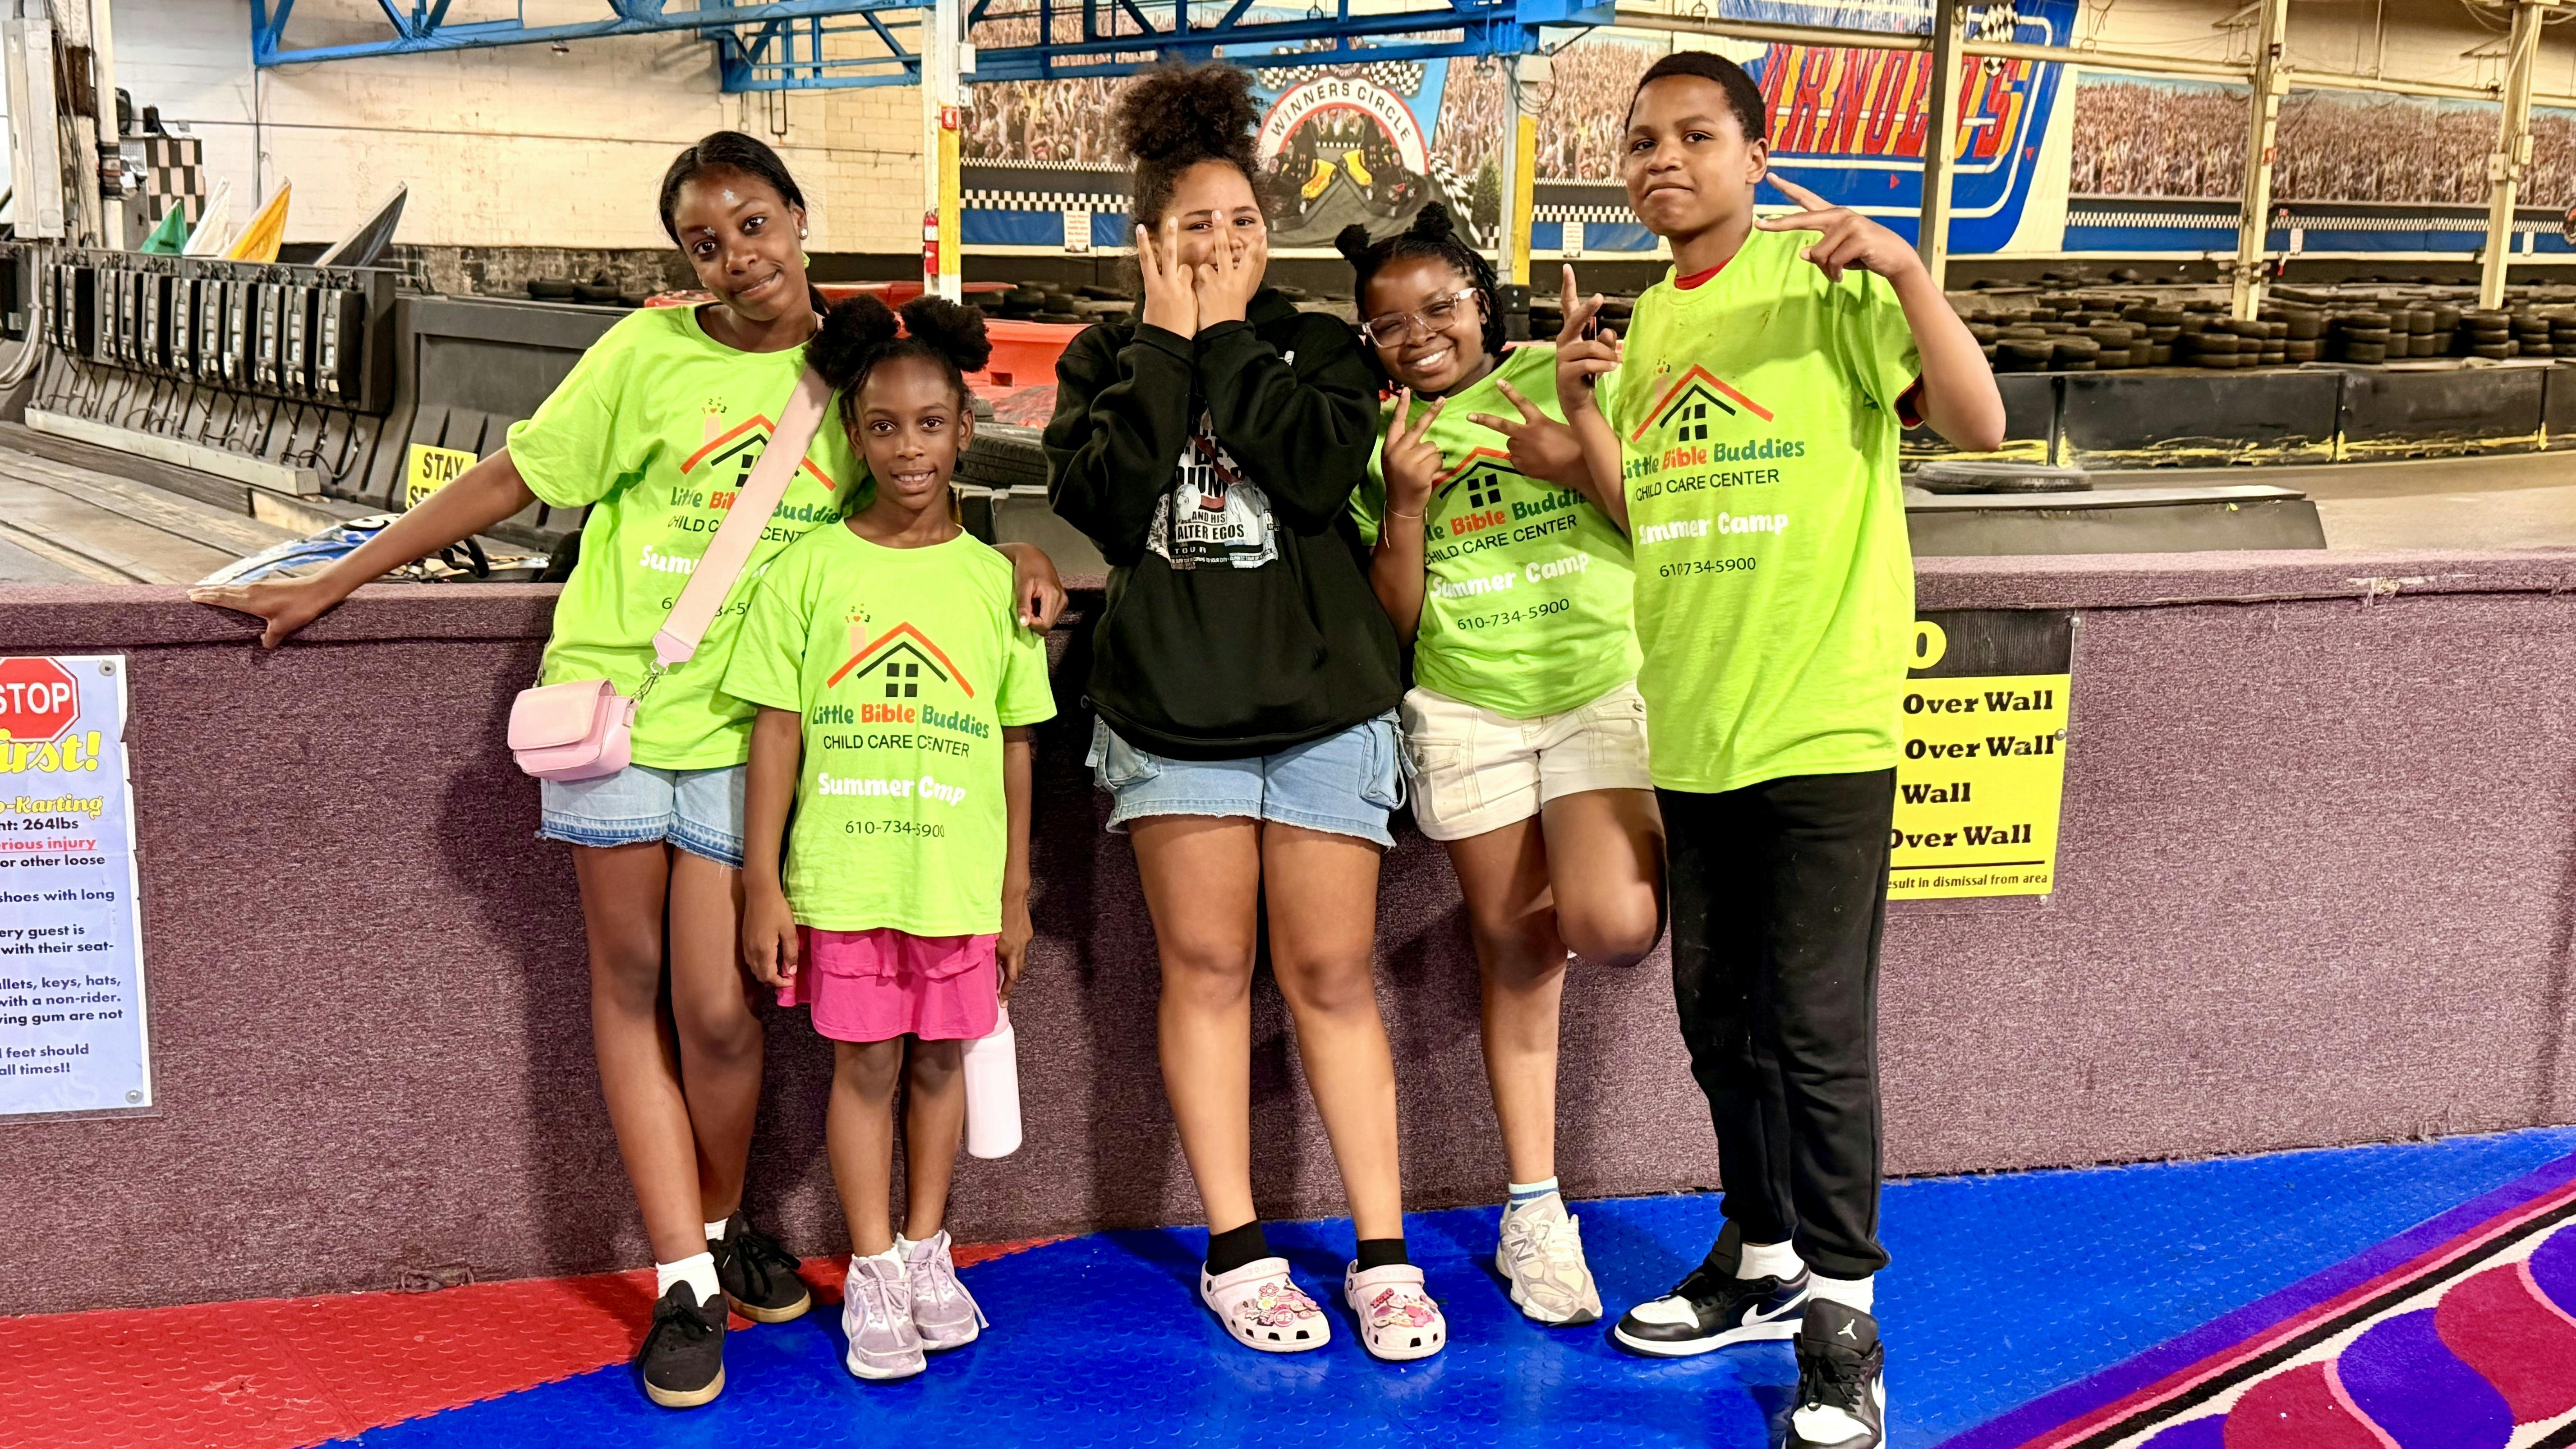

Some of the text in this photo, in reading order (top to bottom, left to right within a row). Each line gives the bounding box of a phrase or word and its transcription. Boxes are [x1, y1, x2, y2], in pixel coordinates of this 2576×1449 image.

[1271, 82, 1411, 141] WINNERS CIRCLE
[1662, 446, 1707, 470] Bible
[1714, 438, 1805, 463] Buddies
[423, 452, 464, 481] STAY
[1636, 469, 1780, 501] CHILD CARE CENTER
[1192, 511, 1225, 523] AND HIS
[1450, 510, 1506, 536] Bible
[1717, 511, 1789, 536] Camp
[1178, 524, 1245, 540] ALTER EGOS
[1462, 532, 1509, 554] CARE
[1513, 514, 1577, 542] CENTER
[1174, 546, 1206, 554] TOUR
[1429, 552, 1590, 598] Summer Camp
[1457, 598, 1570, 630] 610-734-5900
[1903, 690, 2053, 715] Over Wall
[812, 703, 989, 739] Little Bible Buddies
[823, 734, 970, 758] CHILD CARE CENTER
[1904, 734, 2055, 760] Over Wall
[818, 772, 915, 797] Summer
[1901, 782, 1971, 805] Wall
[23, 817, 79, 830] 264lbs
[845, 820, 945, 838] 610-734-5900
[0, 836, 97, 851] rious injury
[1963, 823, 2031, 846] Wall
[20, 856, 59, 867] other
[64, 854, 106, 866] loose
[1887, 874, 2048, 889] esult in dismissal from area
[43, 889, 77, 902] with
[81, 888, 115, 902] long
[28, 925, 69, 939] guest
[73, 924, 85, 935] is
[2, 941, 115, 955] with their seat-
[41, 977, 82, 990] keys,
[85, 975, 121, 987] hats,
[32, 998, 42, 1006] a
[46, 993, 122, 1005] non-rider.
[32, 1014, 65, 1026] gum
[69, 1012, 95, 1021] are
[98, 1009, 123, 1020] not
[6, 1047, 36, 1058] feet
[40, 1043, 89, 1057] should
[0, 1062, 71, 1076] all times!!
